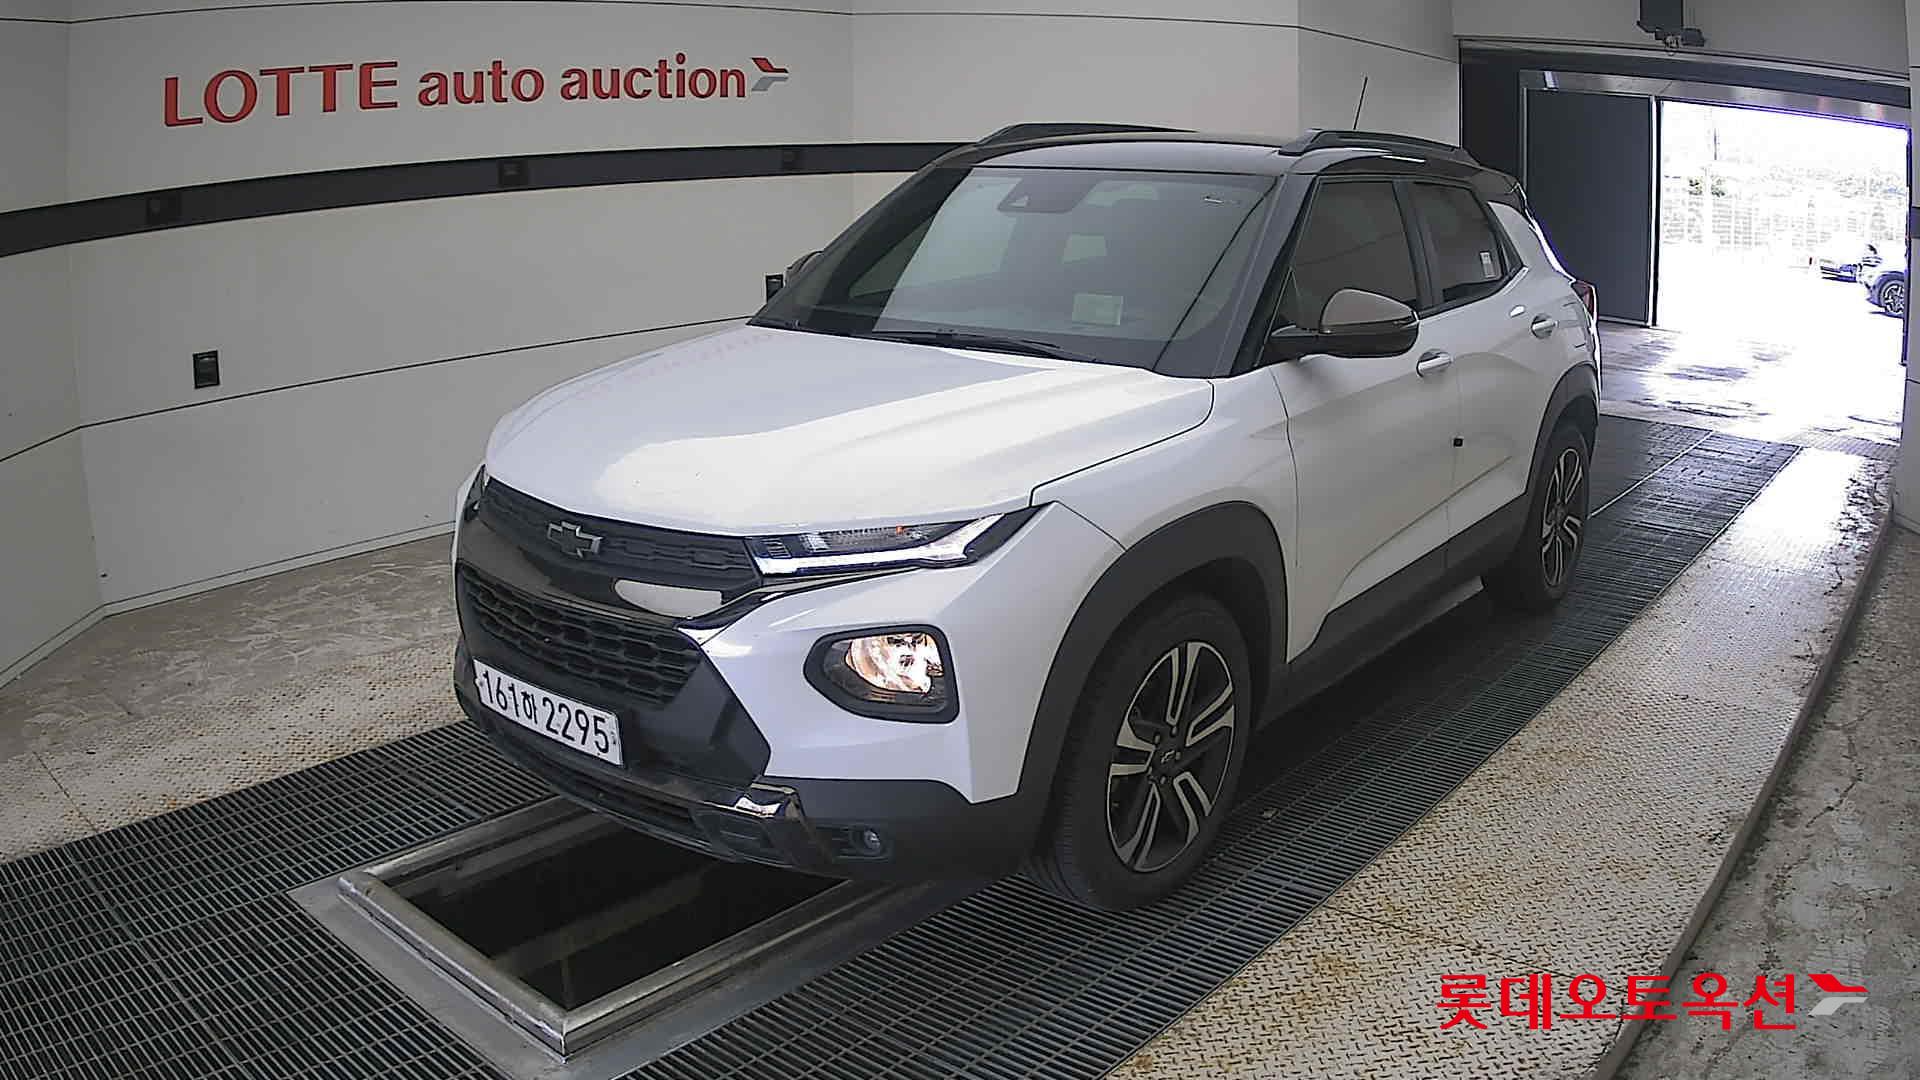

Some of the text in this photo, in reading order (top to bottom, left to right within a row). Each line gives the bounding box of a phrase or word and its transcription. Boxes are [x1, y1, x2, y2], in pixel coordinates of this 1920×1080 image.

[164, 52, 747, 128] LOTTE auto auction
